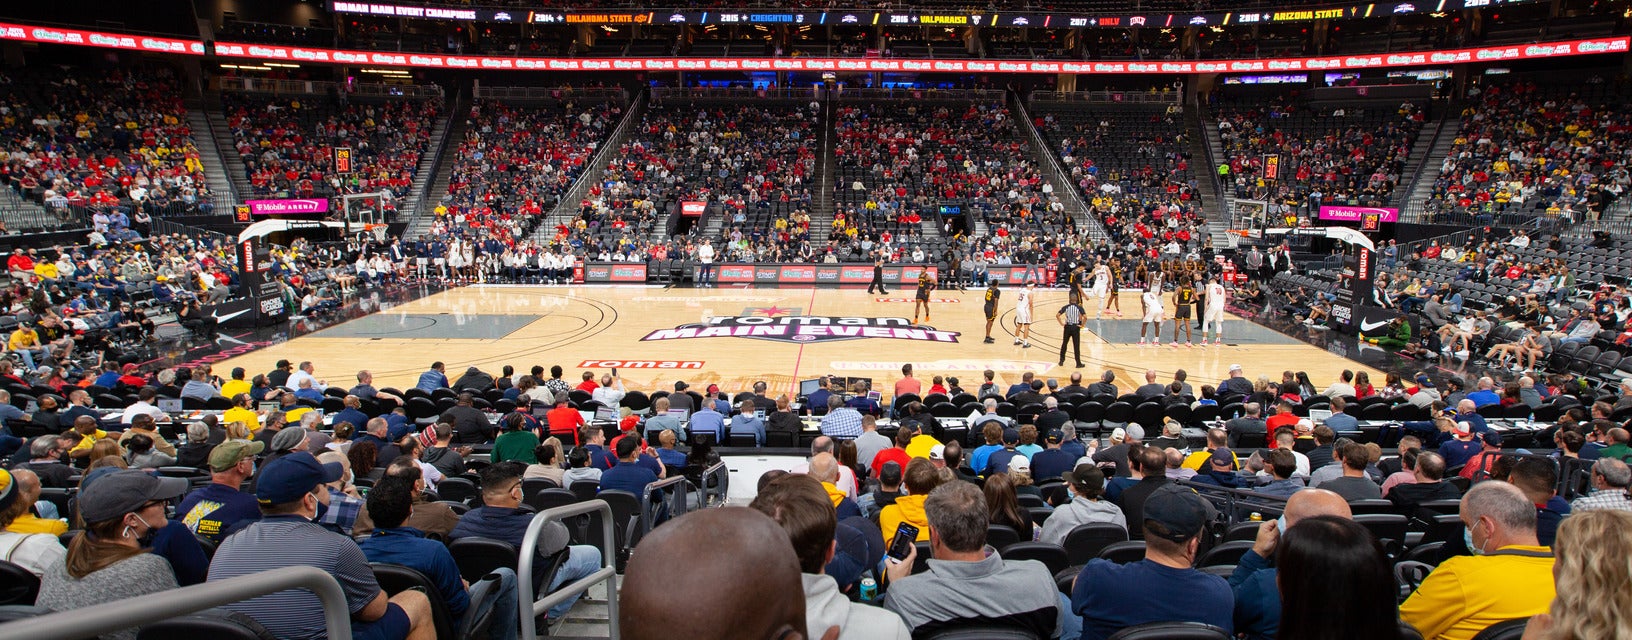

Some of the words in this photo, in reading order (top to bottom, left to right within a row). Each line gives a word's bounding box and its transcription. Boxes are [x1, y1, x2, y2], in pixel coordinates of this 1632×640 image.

[334, 2, 368, 13] ROMAN
[370, 4, 394, 14] MAIN
[396, 6, 424, 17] EVENT
[426, 8, 476, 19] CHAMPIONS
[1273, 10, 1313, 20] ARIZONA
[1314, 9, 1344, 19] STATE
[535, 14, 554, 22] 2014
[566, 14, 608, 23] OKLAHOMA
[750, 14, 793, 22] CREIGHTON
[338, 158, 348, 171] 30
[1266, 164, 1276, 178] 30
[245, 242, 253, 270] roman
[1184, 292, 1189, 300] 5
[710, 316, 911, 326] roman
[646, 325, 787, 340] MAIN
[798, 325, 960, 341] EVENT
[582, 360, 702, 368] roman
